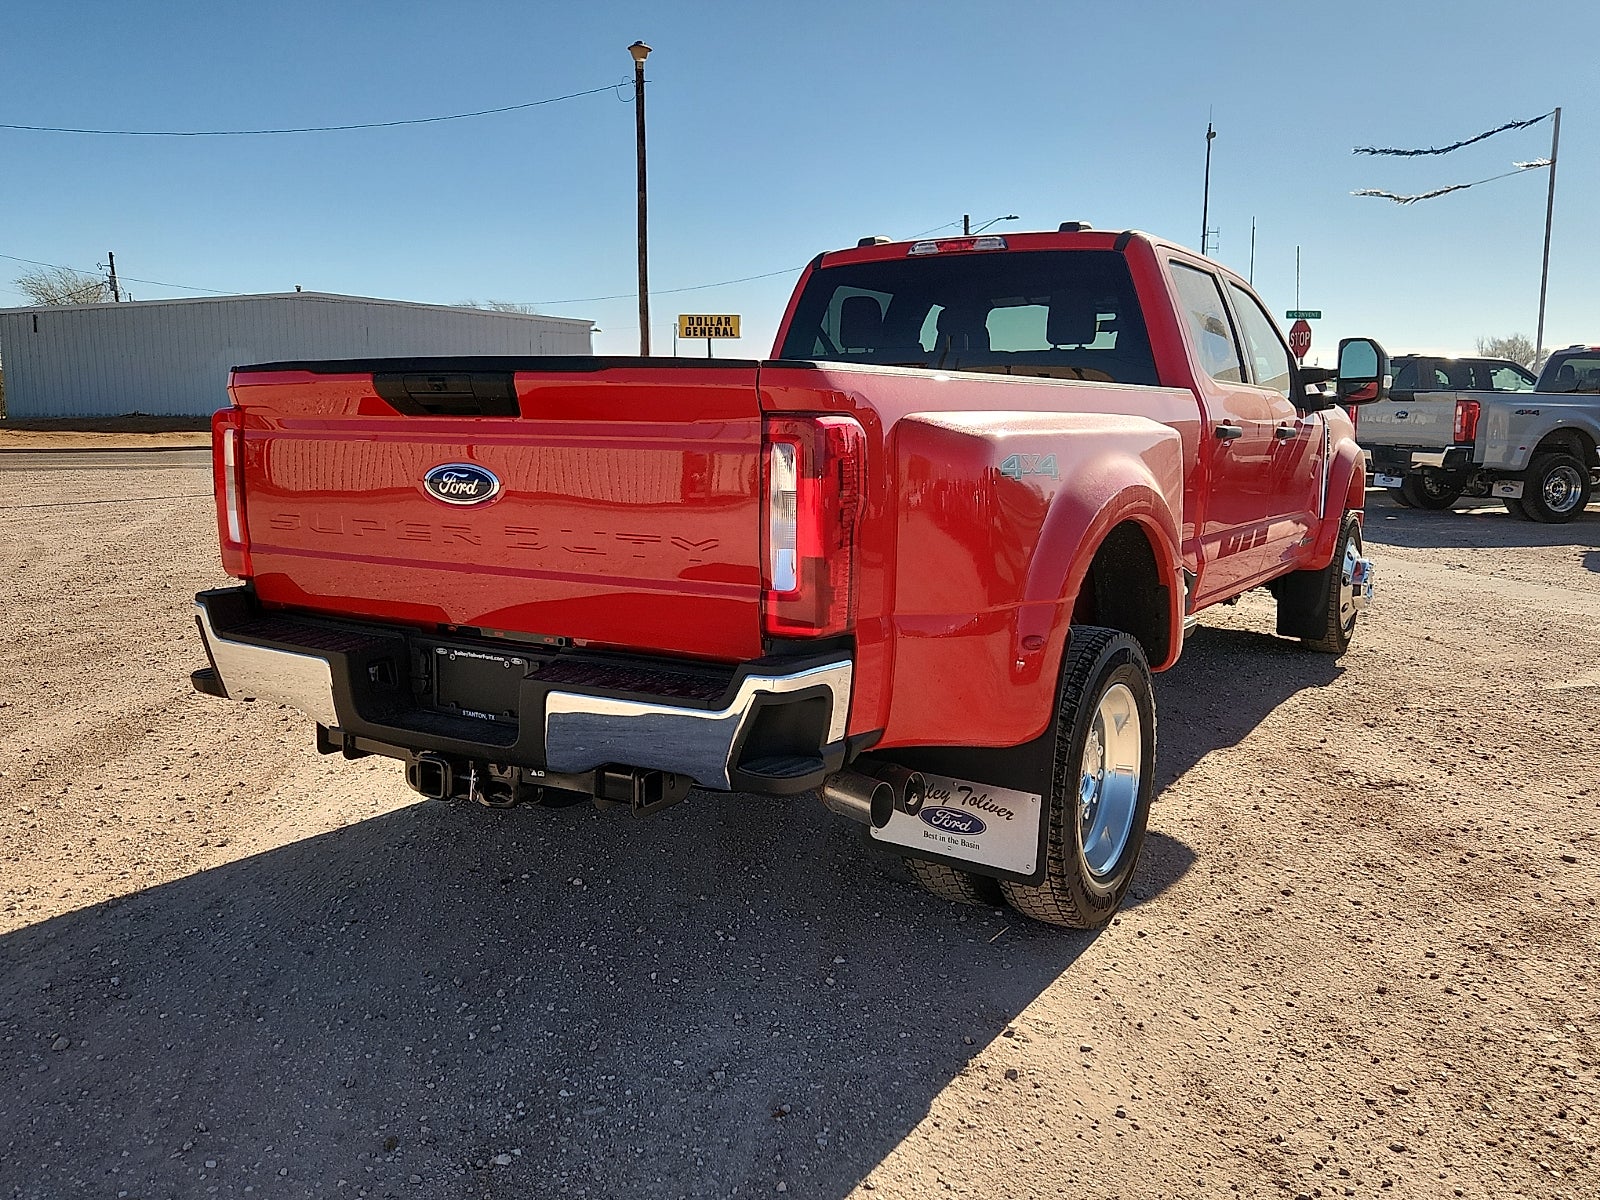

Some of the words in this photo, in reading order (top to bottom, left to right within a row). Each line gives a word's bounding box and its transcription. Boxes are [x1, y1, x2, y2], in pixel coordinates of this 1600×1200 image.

[685, 327, 735, 337] GENERAL
[688, 316, 731, 326] DOLLAR
[1290, 331, 1310, 347] STOP
[438, 471, 480, 495] Ford
[269, 513, 482, 547] SUPER
[504, 525, 720, 562] DUTY
[924, 782, 951, 806] ley
[957, 785, 1015, 821] Toliver
[931, 808, 972, 832] Ford
[923, 830, 938, 840] Best
[939, 834, 946, 842] in
[947, 836, 959, 845] the
[960, 839, 980, 850] Basin
